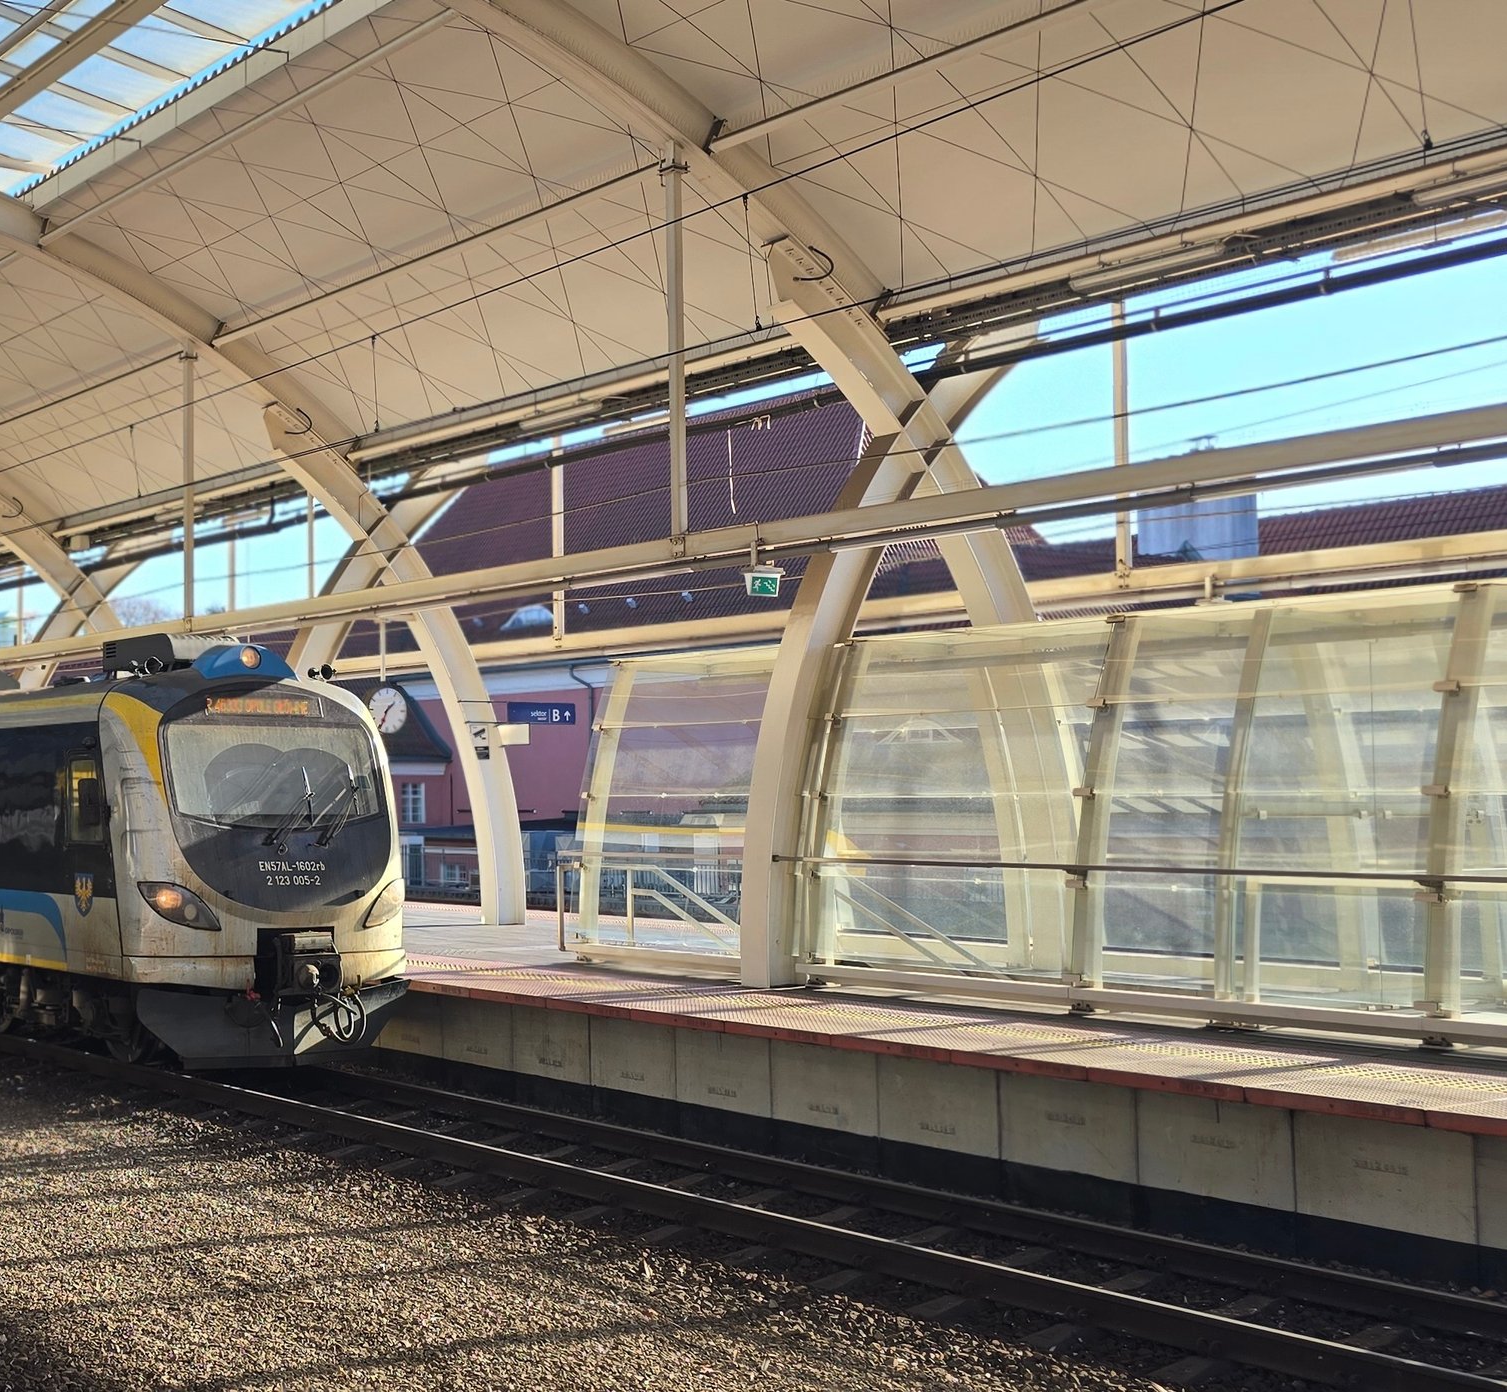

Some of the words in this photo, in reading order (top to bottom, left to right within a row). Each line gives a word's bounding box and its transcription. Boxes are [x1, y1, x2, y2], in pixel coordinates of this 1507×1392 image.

[530, 709, 548, 718] sektor
[552, 708, 561, 722] B
[258, 860, 326, 872] EN57AL-1602rb
[266, 875, 274, 886] 2
[274, 875, 291, 886] 123
[292, 875, 322, 886] 005-2
